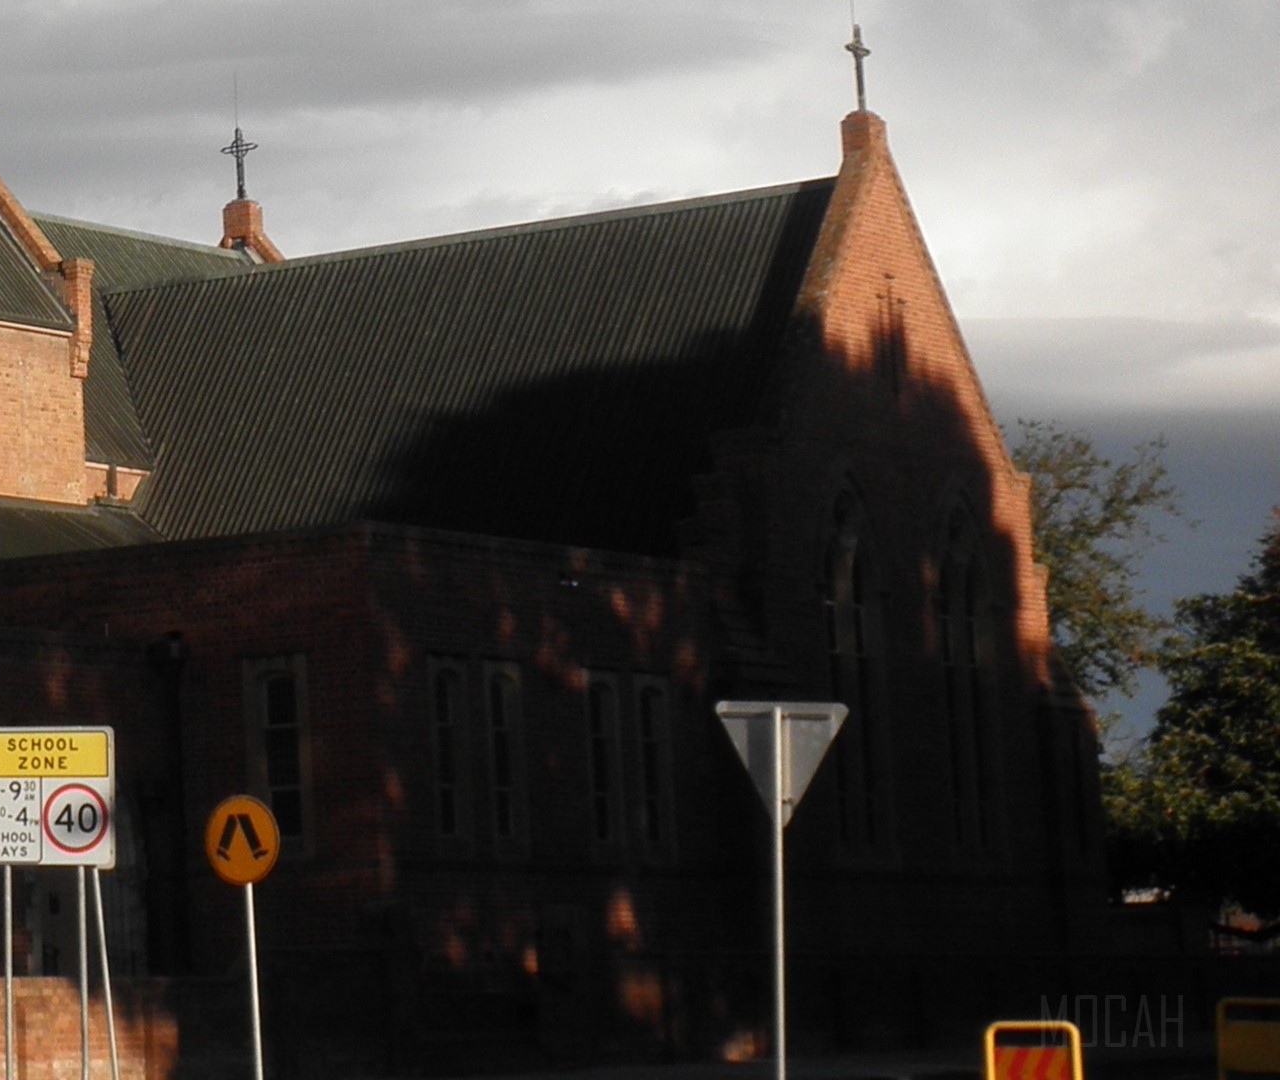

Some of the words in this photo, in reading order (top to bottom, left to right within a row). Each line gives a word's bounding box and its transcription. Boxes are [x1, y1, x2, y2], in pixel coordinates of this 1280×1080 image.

[7, 738, 78, 752] SCHOOL
[18, 756, 68, 769] ZONE
[54, 803, 98, 833] 40
